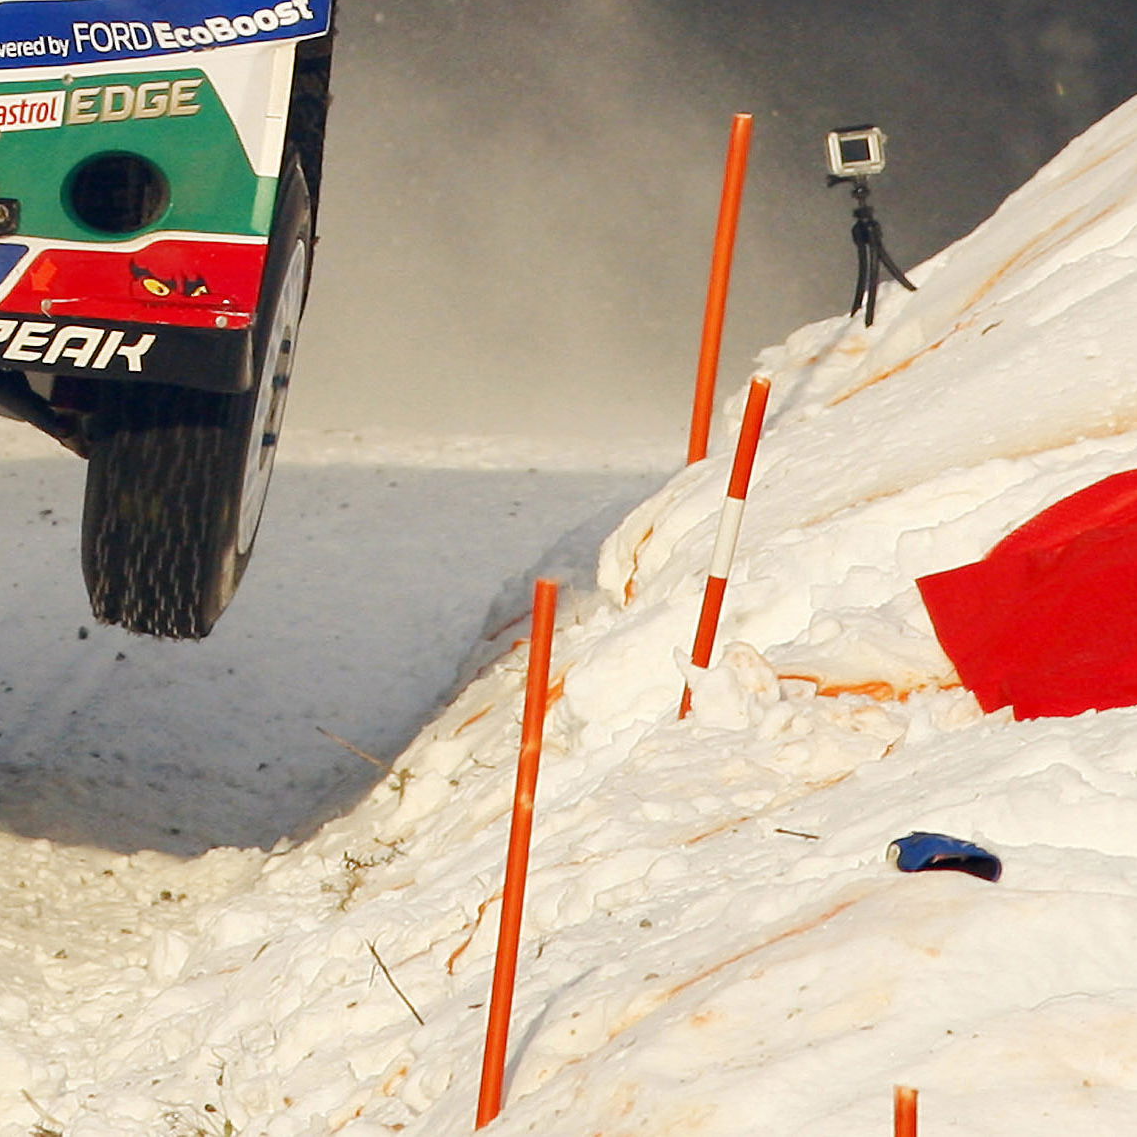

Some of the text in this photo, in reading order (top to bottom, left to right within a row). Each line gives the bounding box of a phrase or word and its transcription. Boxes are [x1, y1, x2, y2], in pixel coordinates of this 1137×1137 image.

[48, 35, 70, 58] by
[72, 22, 154, 54] FORD
[64, 78, 206, 125] EDGE
